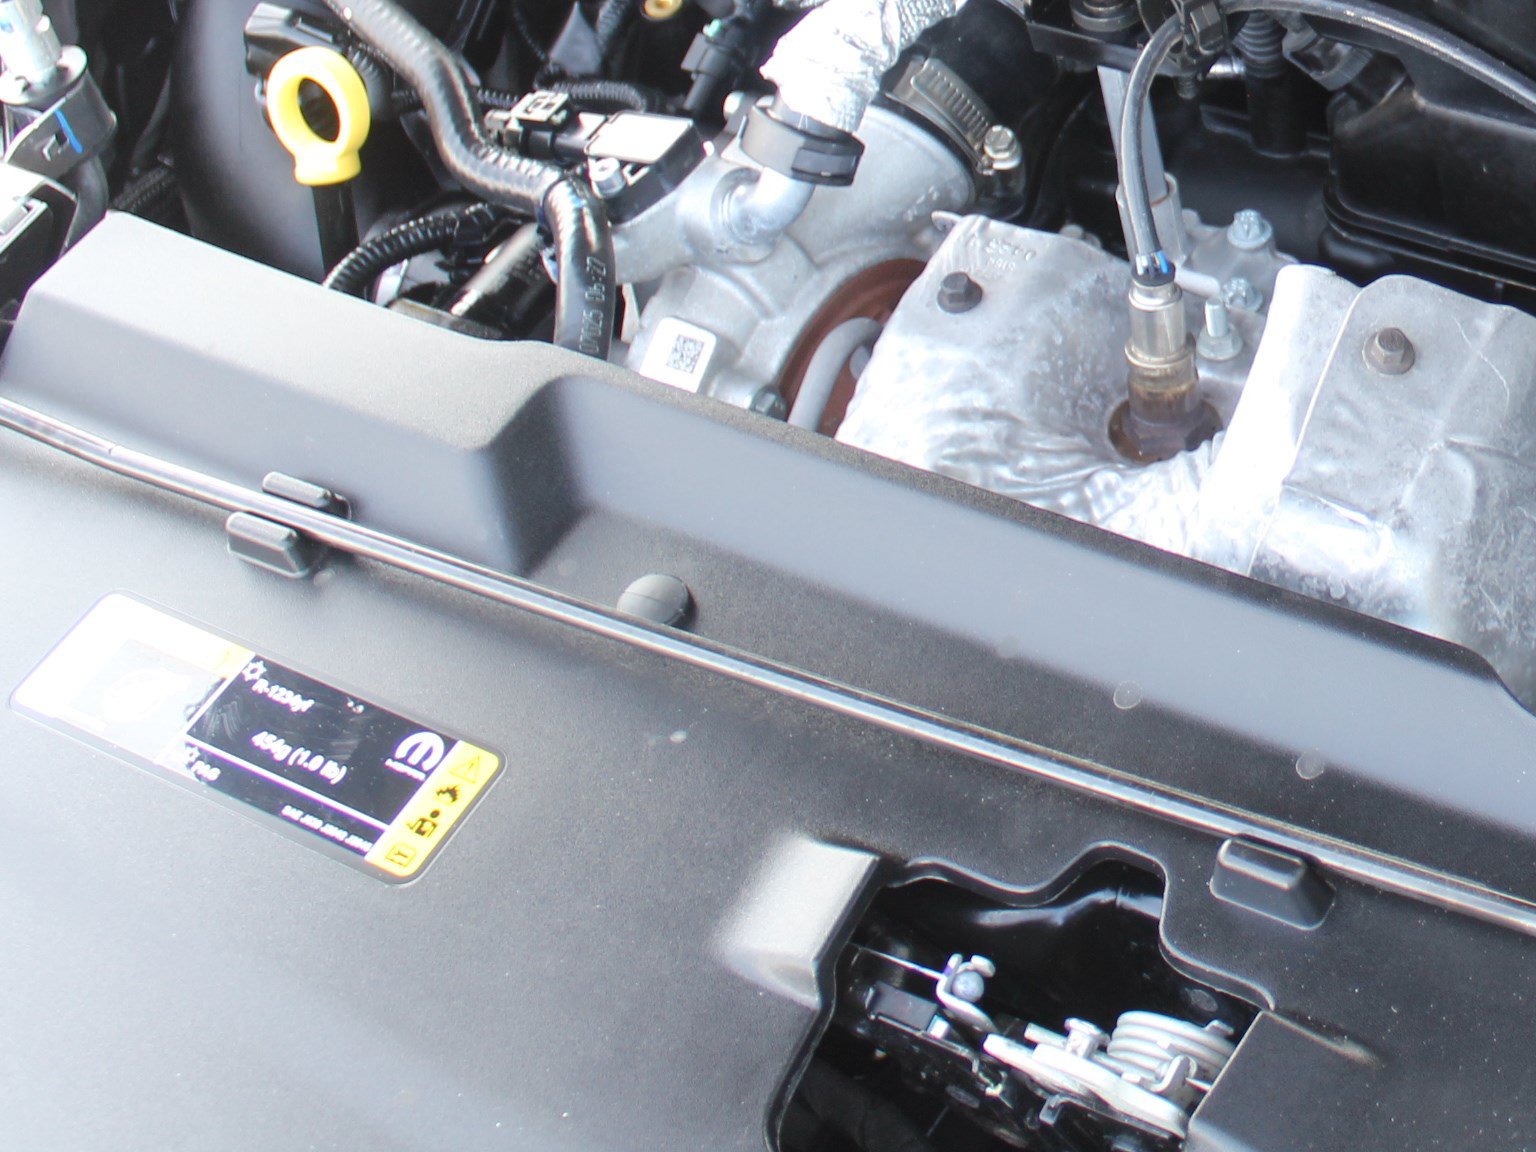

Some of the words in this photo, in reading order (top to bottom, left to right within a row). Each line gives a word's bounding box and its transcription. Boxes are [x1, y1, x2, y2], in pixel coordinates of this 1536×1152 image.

[252, 678, 315, 712] R-1234yf
[252, 730, 292, 761] 454g
[288, 747, 325, 773] (1.0
[320, 758, 347, 784] lb)
